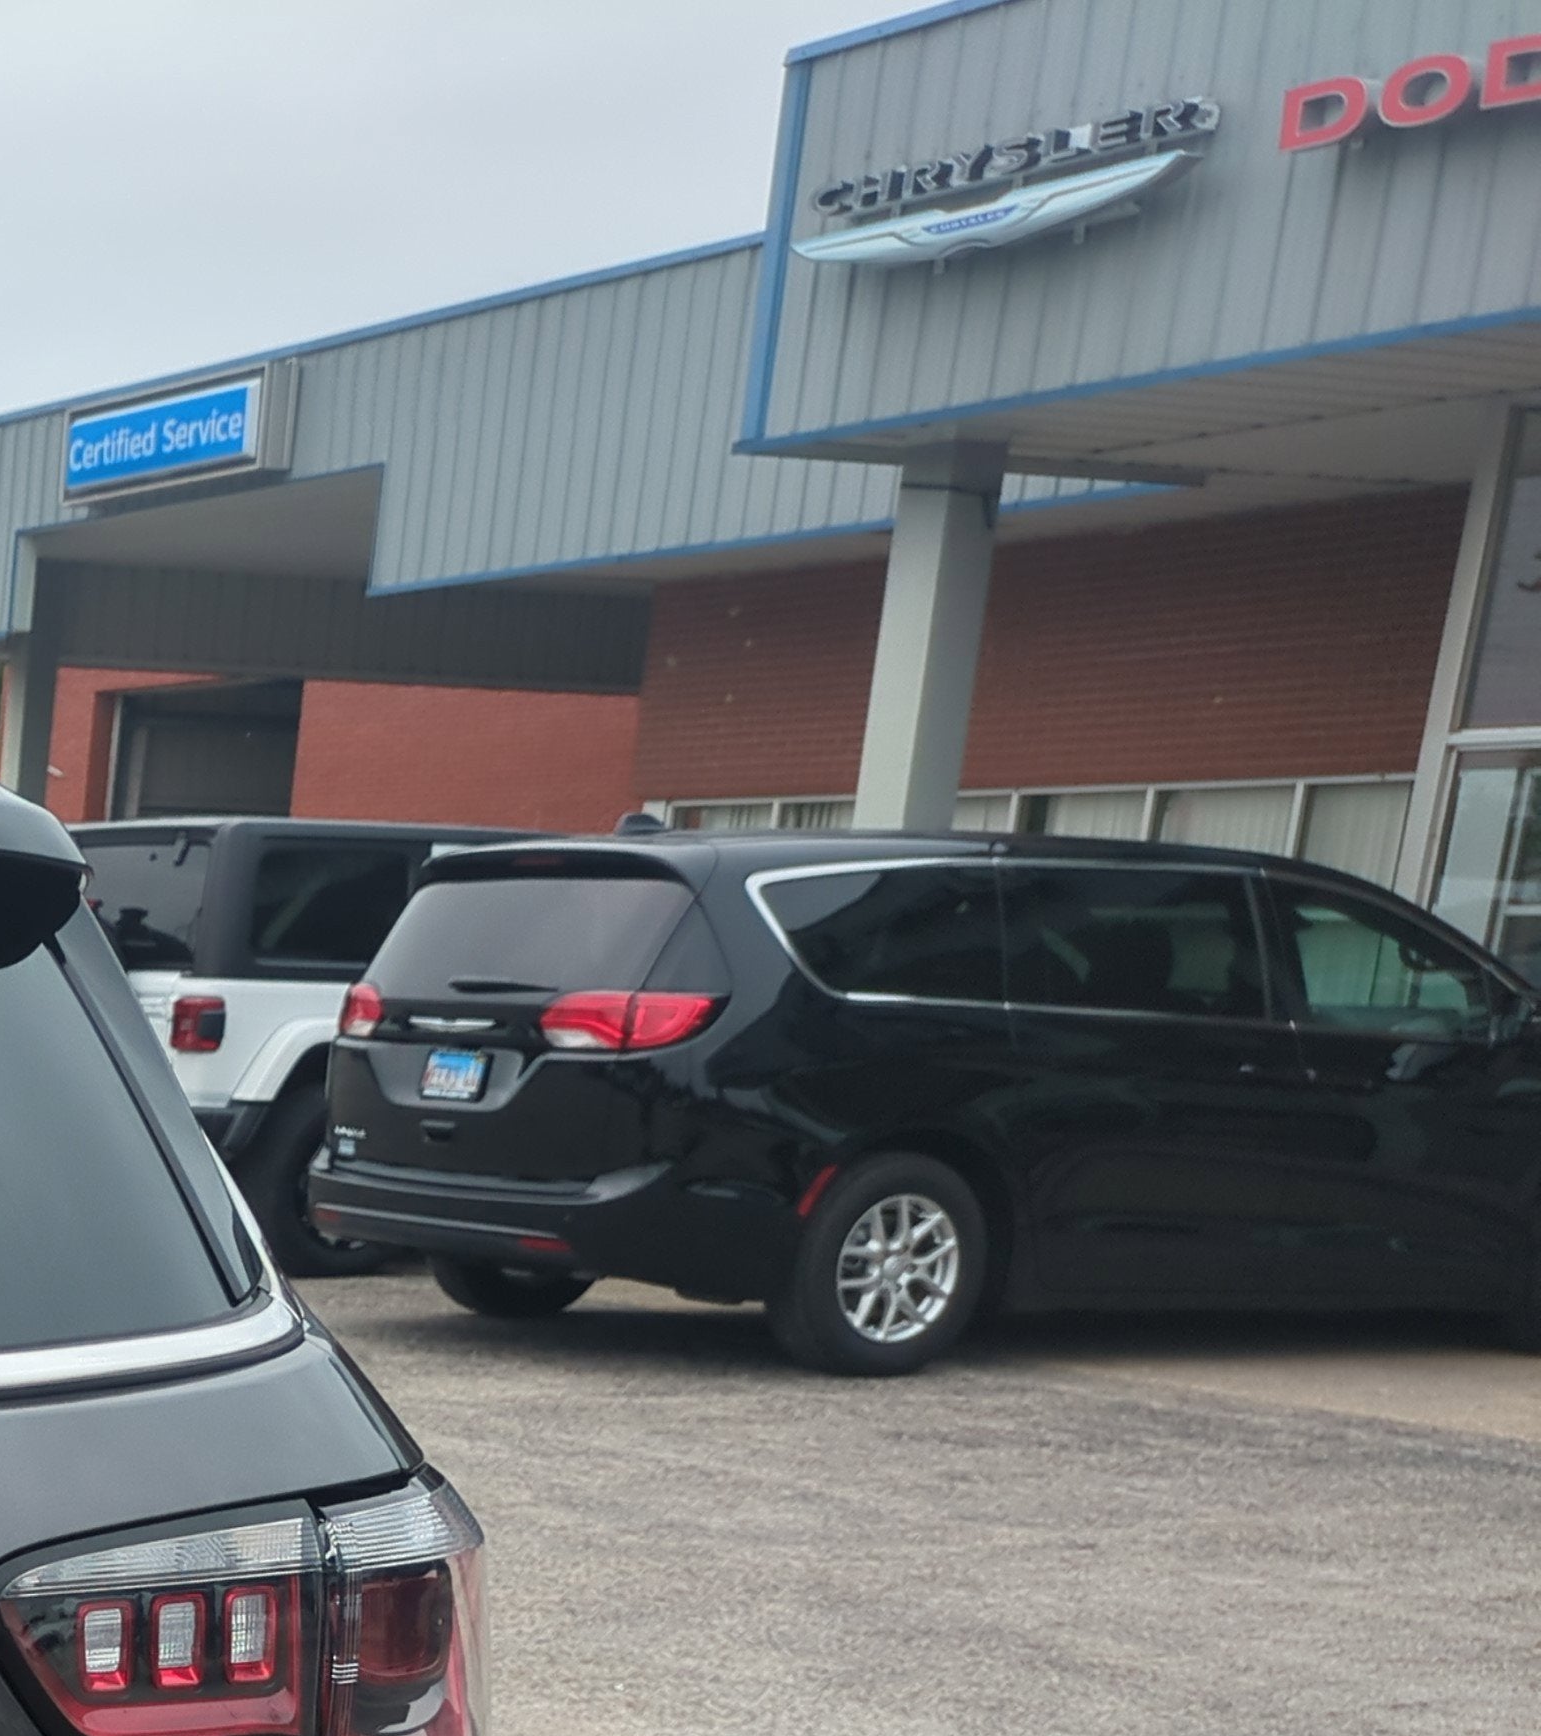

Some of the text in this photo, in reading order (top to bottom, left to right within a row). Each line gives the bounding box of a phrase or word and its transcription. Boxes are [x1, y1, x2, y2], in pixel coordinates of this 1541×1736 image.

[811, 97, 1217, 218] CHRYSLER
[68, 407, 243, 473] Certified Service
